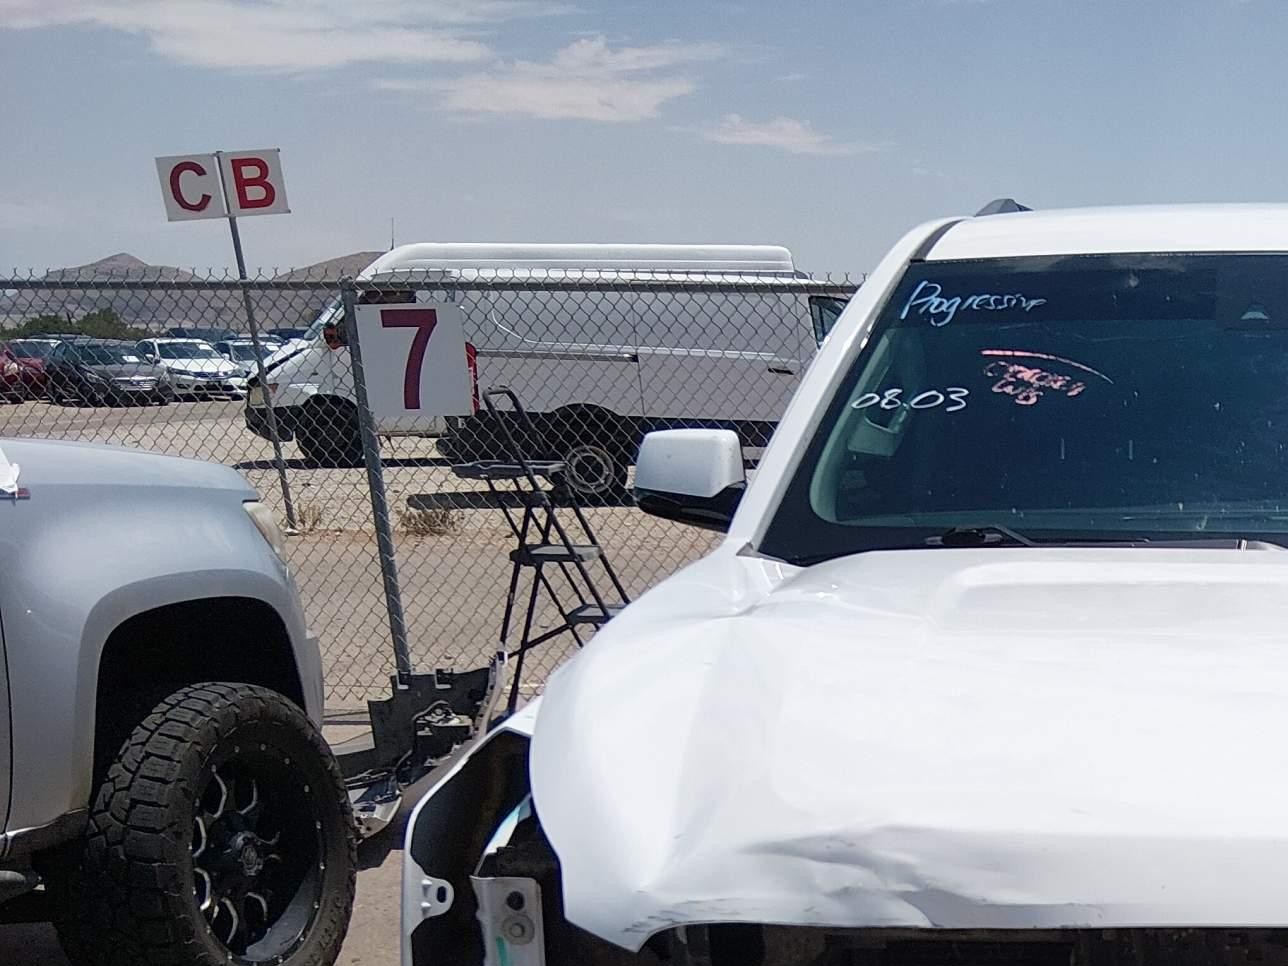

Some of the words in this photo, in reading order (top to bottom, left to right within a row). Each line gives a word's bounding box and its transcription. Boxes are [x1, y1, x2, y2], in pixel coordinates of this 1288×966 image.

[169, 161, 212, 212] C
[230, 157, 276, 209] B
[380, 308, 438, 410] 7
